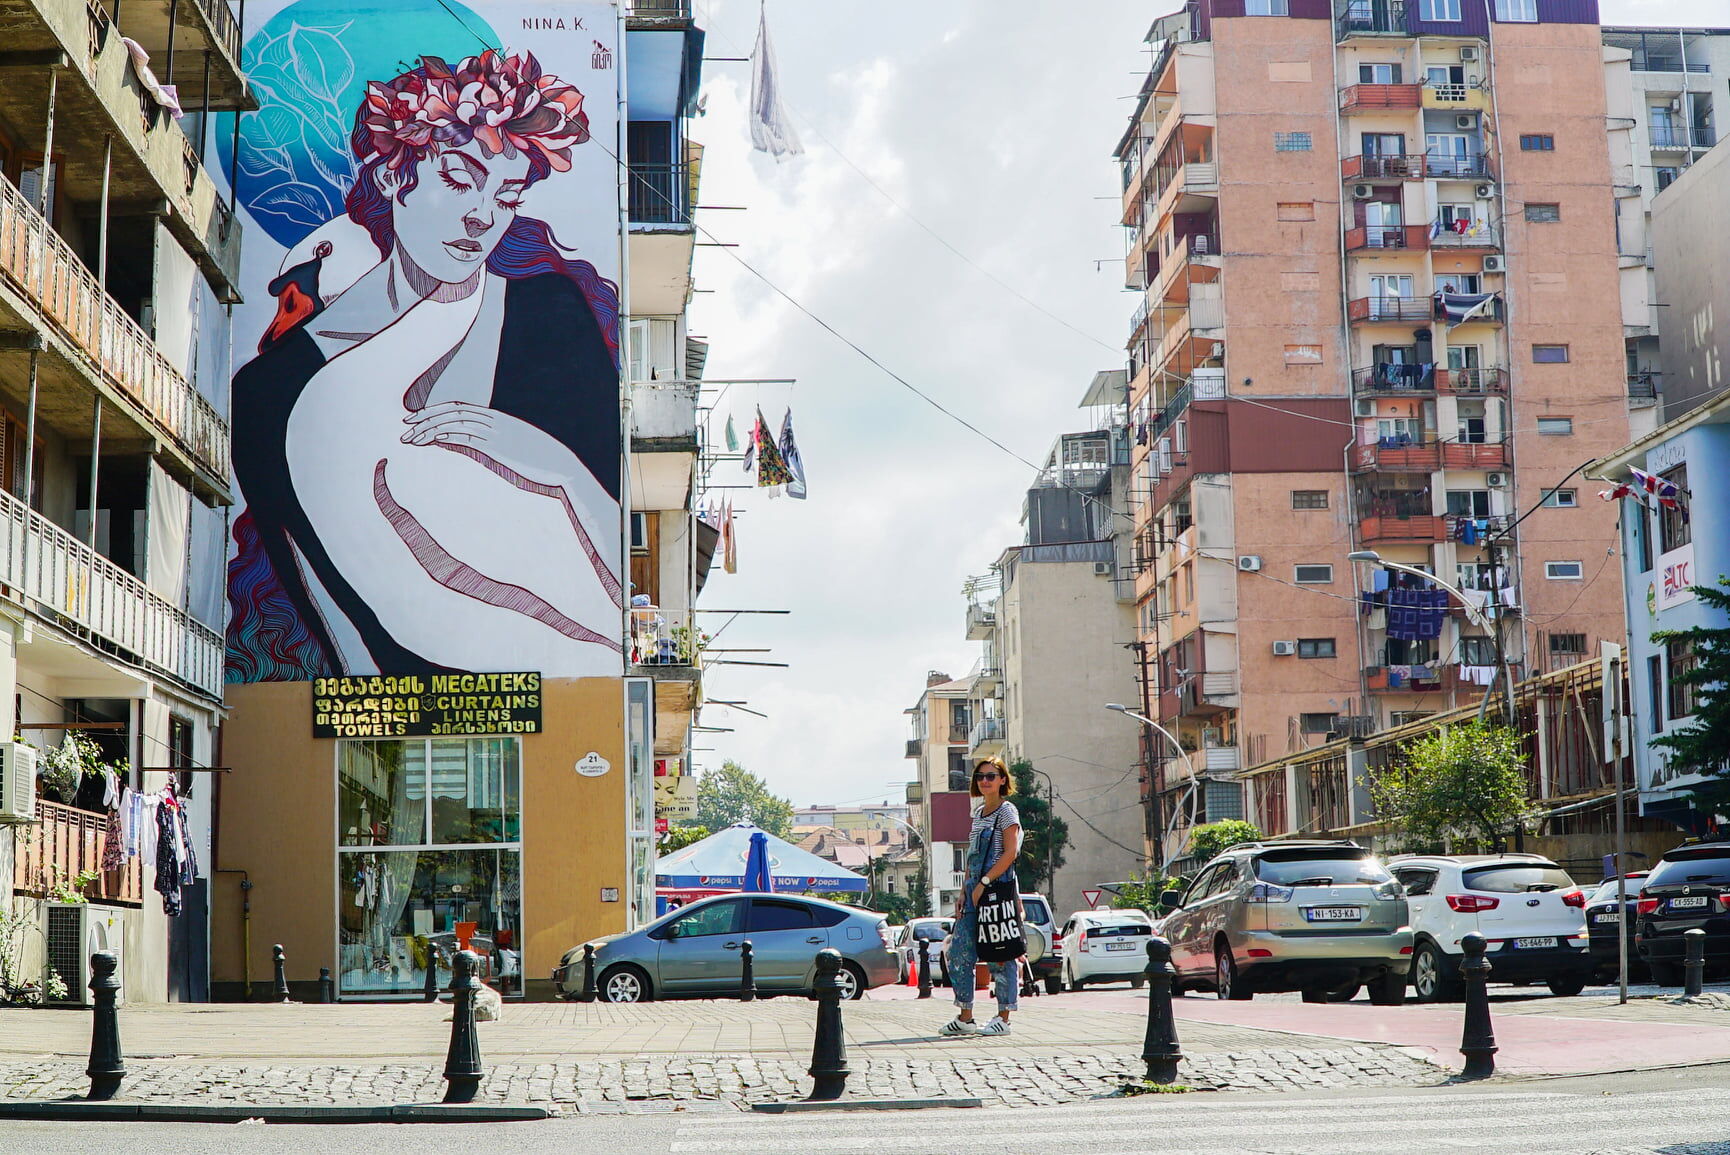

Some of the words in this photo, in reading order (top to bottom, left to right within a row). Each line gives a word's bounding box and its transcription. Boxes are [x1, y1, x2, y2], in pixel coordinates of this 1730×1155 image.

[314, 676, 424, 696] მეგატექს
[431, 673, 540, 693] MEGATEKS
[315, 697, 419, 712] ფარდები
[437, 695, 539, 710] CURTAINS
[443, 709, 511, 722] LINENS
[333, 723, 406, 737] TOWELS
[588, 755, 598, 763] 21
[711, 877, 732, 885] pepsi
[1001, 900, 1015, 920] IN
[1314, 909, 1355, 918] NI-153-KA
[978, 924, 987, 943] A
[988, 919, 1021, 943] BAG
